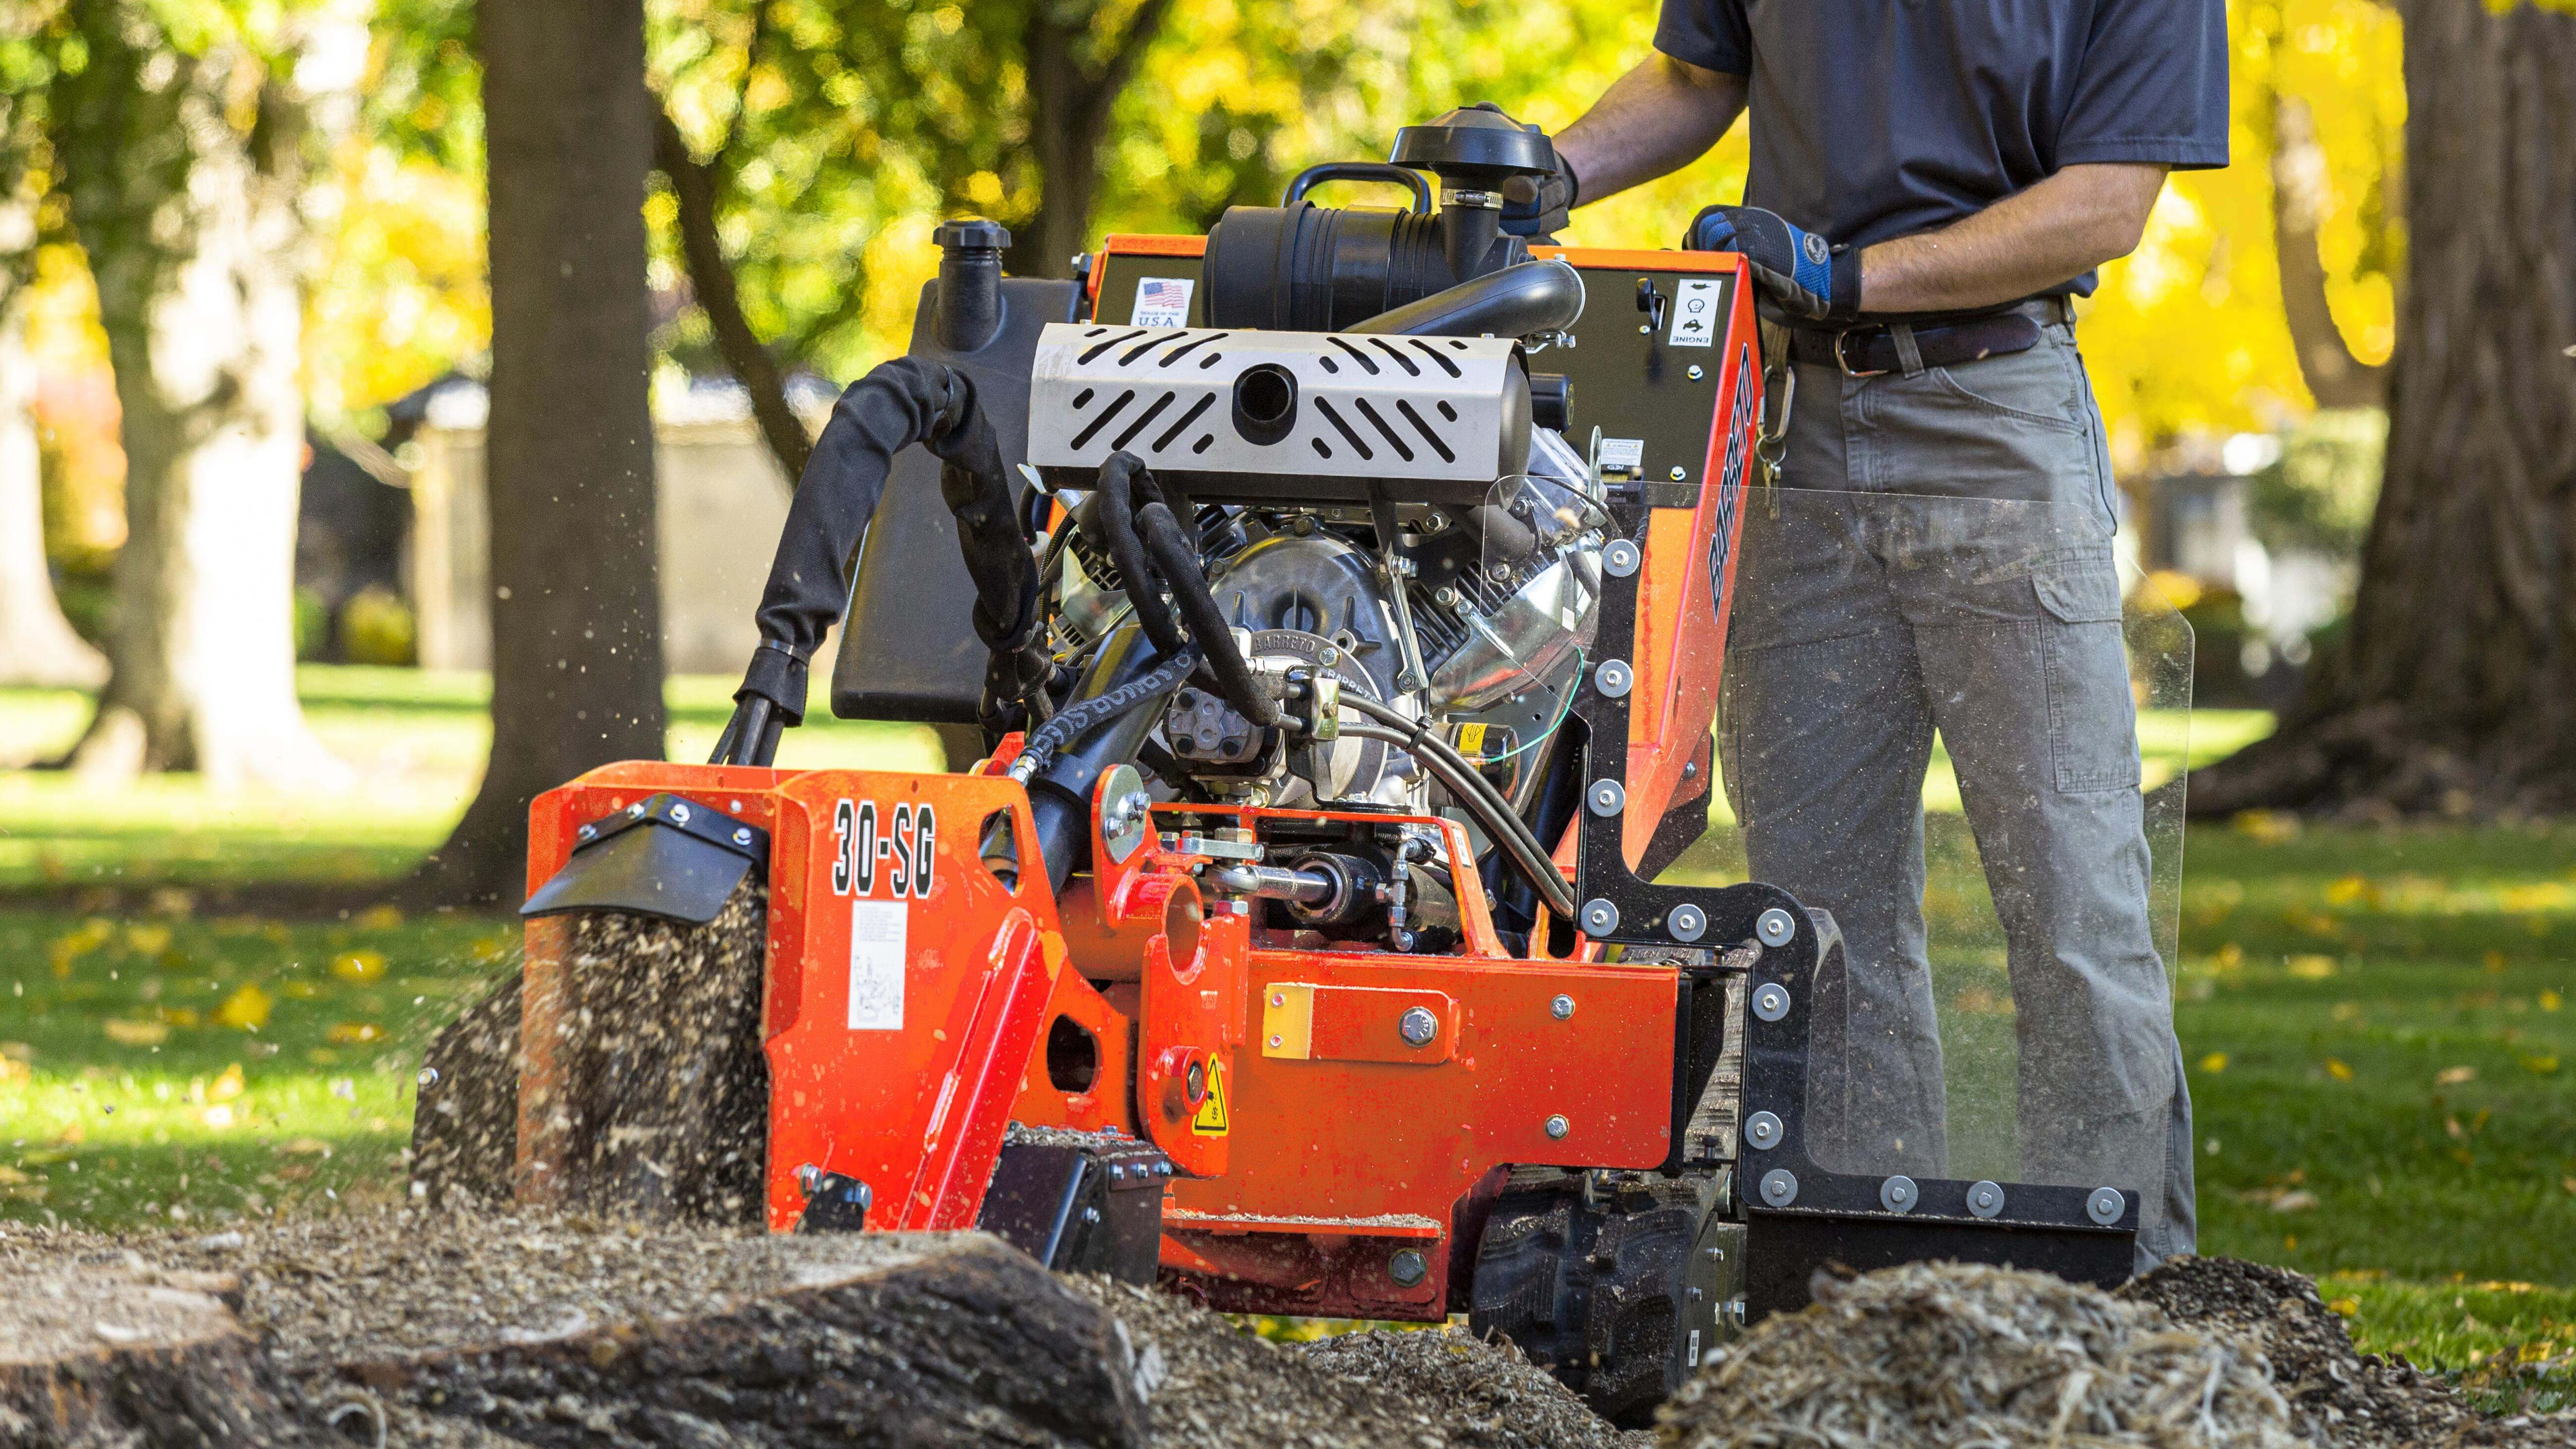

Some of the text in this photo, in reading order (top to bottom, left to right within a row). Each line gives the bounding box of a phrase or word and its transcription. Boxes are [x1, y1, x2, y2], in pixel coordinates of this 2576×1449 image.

[1708, 342, 1753, 625] BARRETO
[1255, 635, 1315, 654] BARRETO
[832, 798, 936, 898] 30-SG
